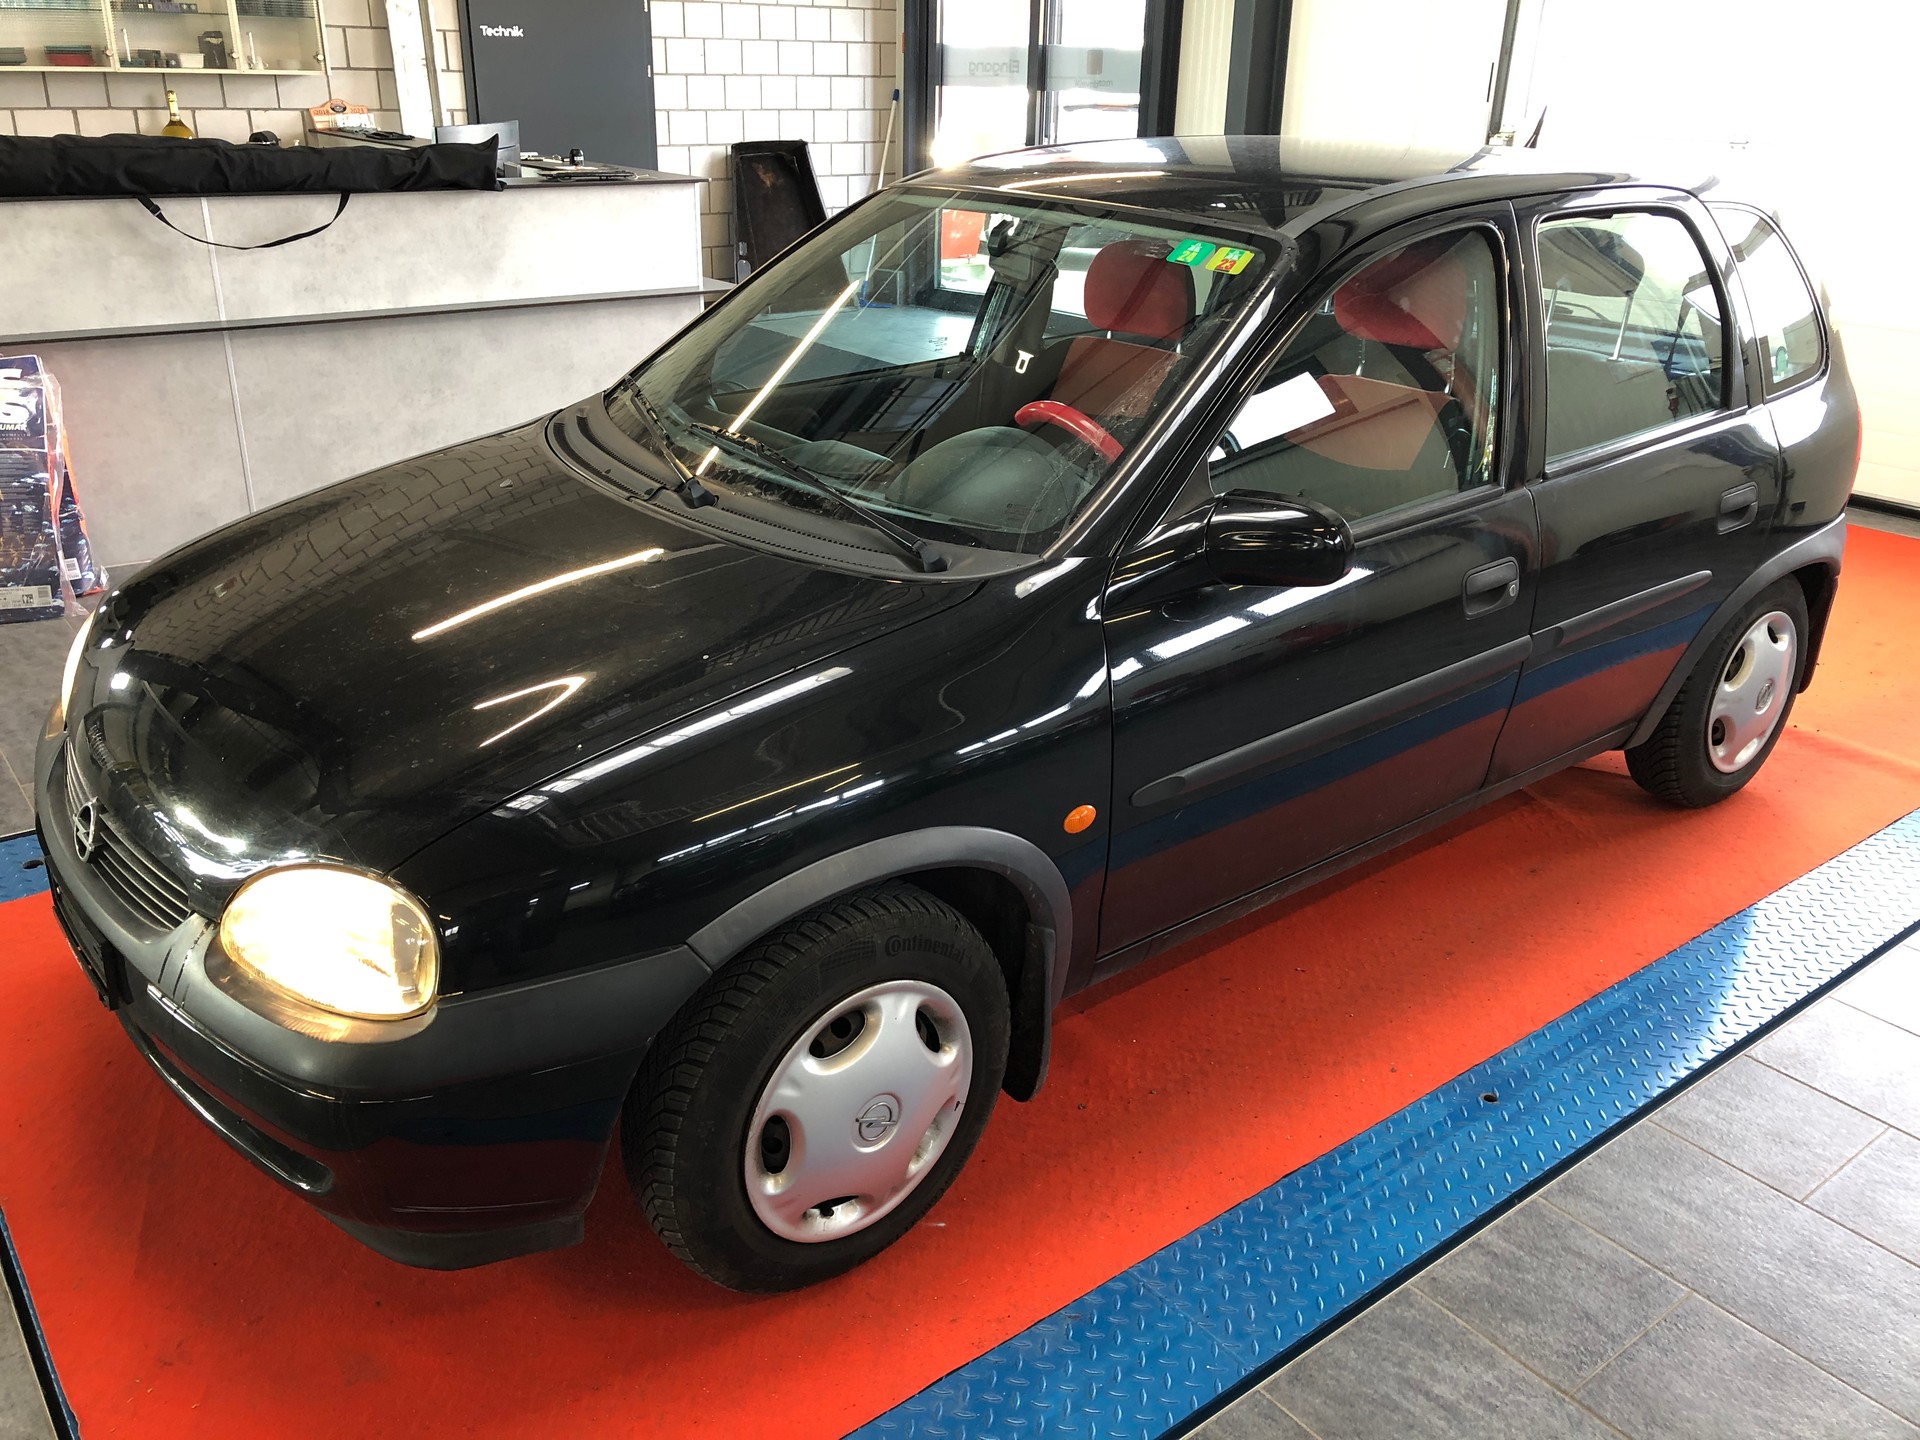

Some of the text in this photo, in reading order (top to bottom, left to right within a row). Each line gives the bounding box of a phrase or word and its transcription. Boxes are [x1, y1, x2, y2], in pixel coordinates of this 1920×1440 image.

[479, 24, 524, 37] Technik
[1215, 258, 1237, 271] 23
[884, 935, 967, 964] Continental
